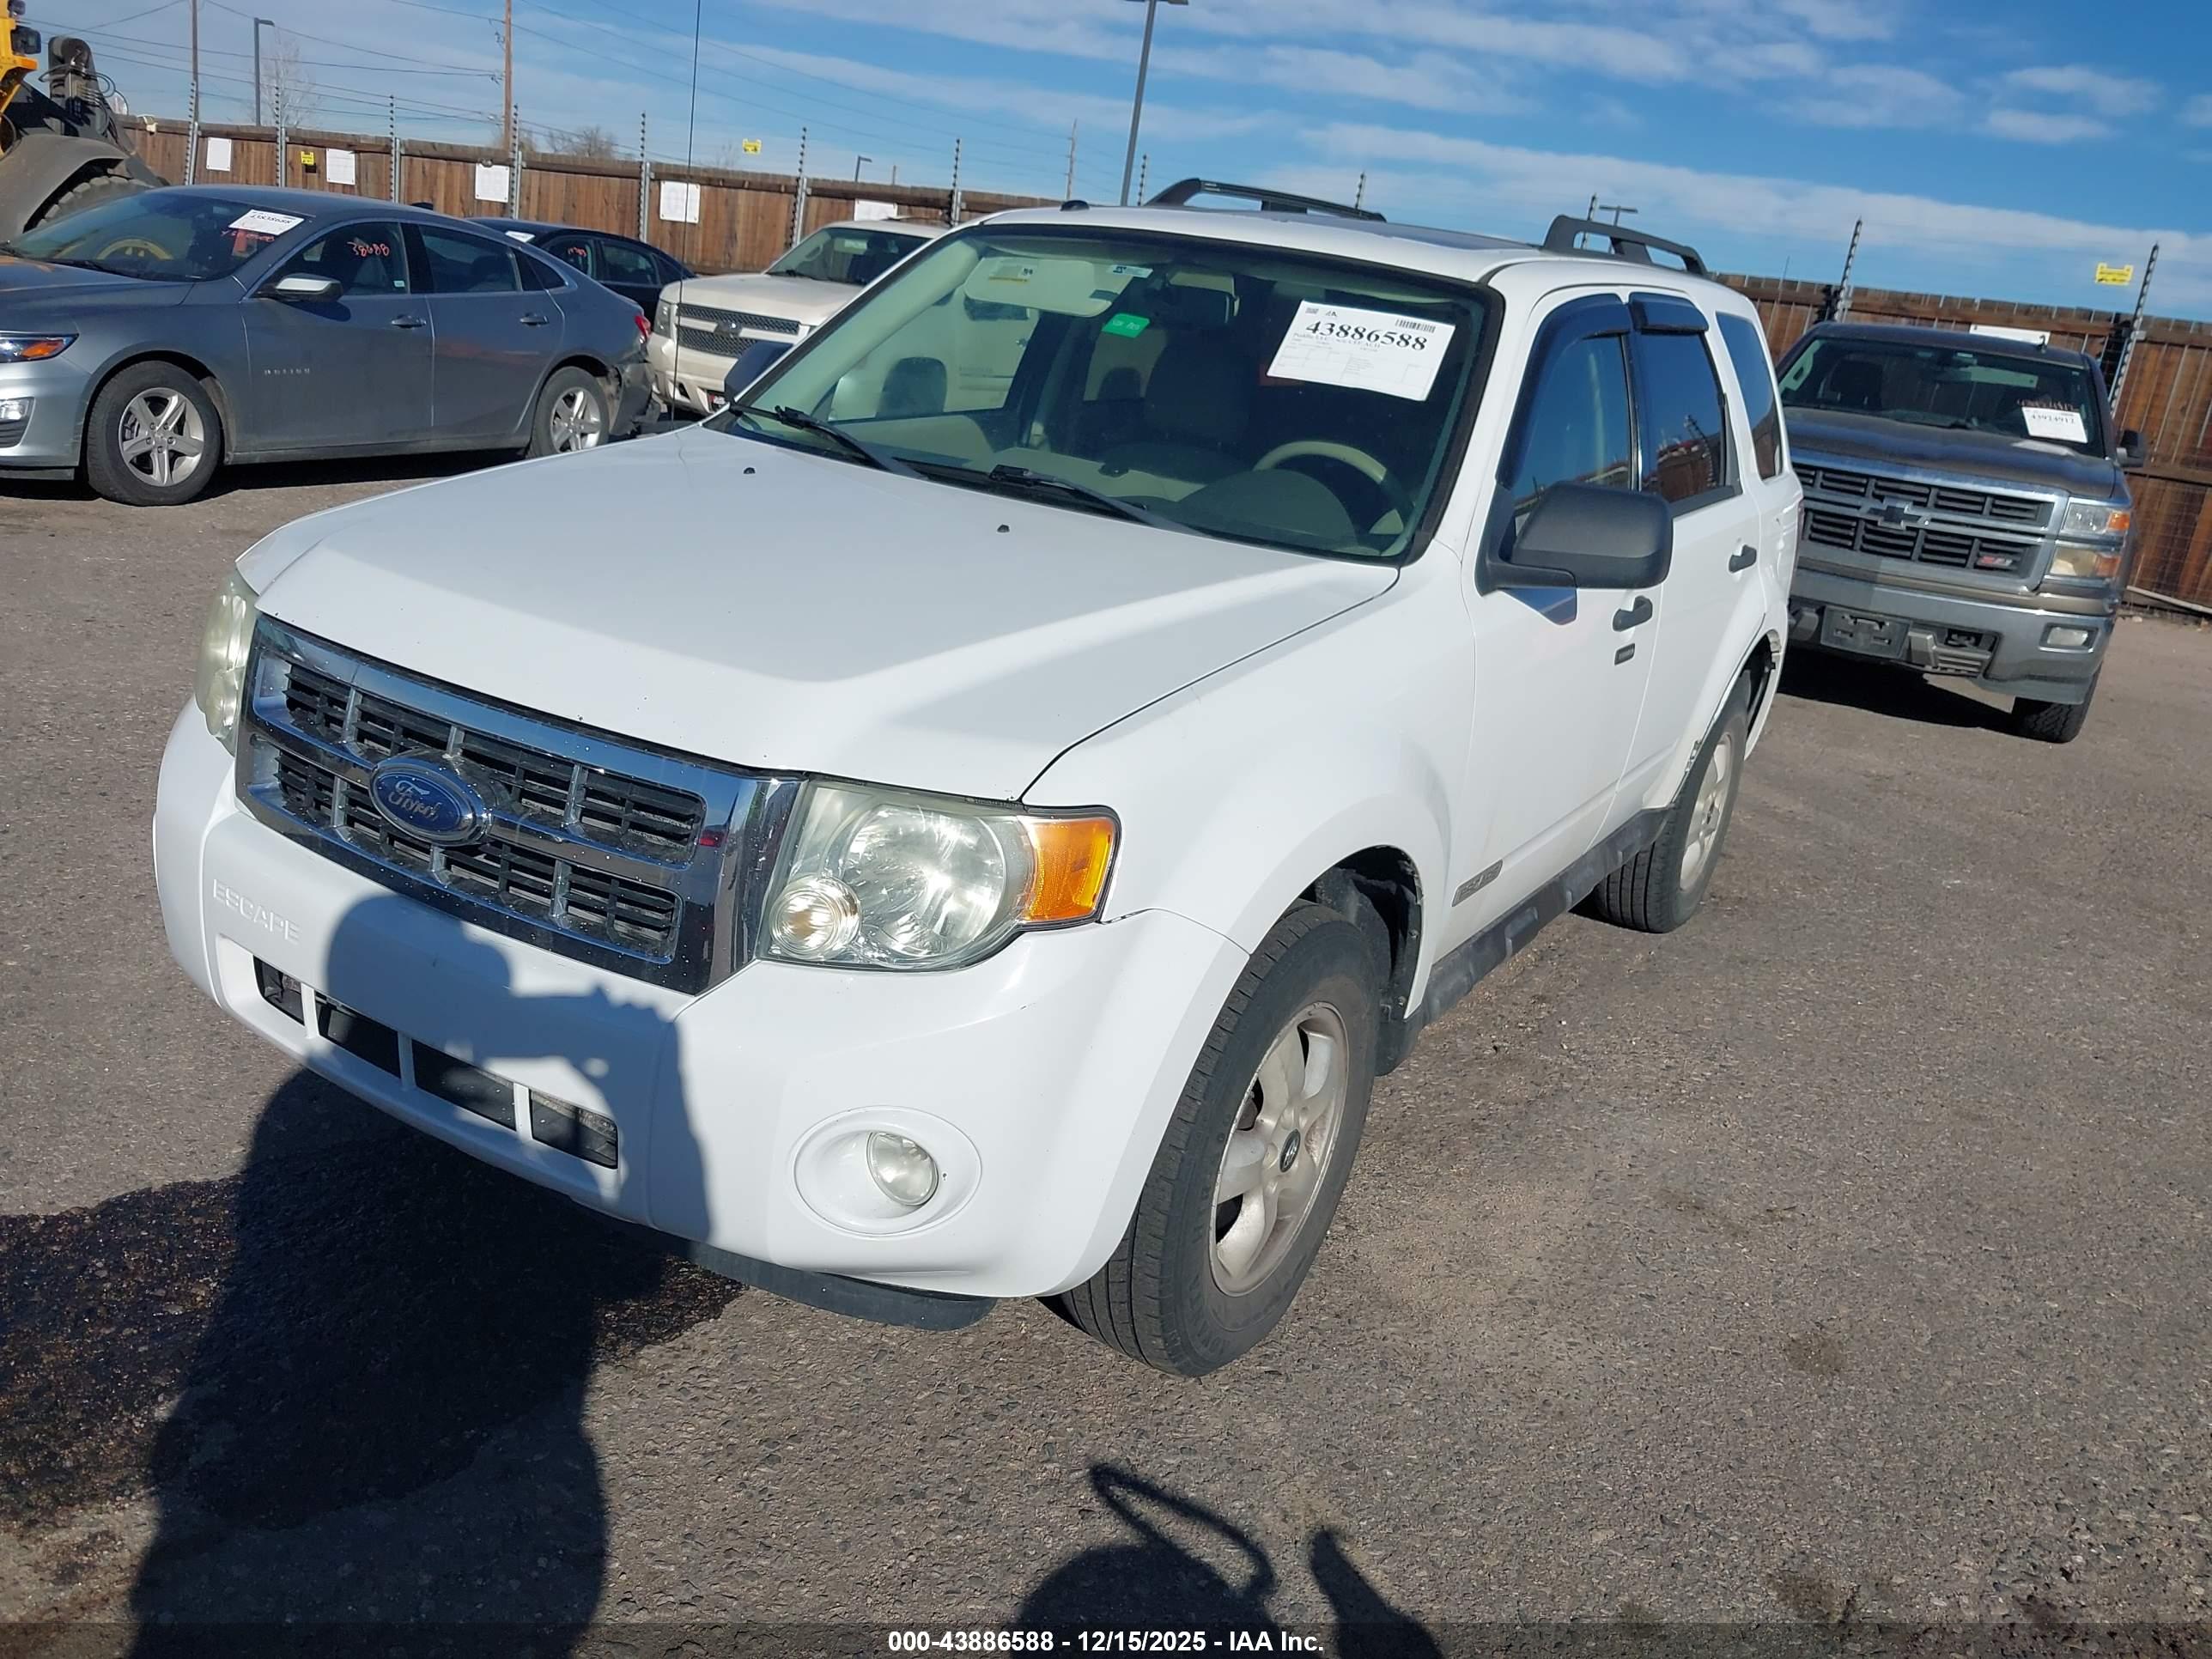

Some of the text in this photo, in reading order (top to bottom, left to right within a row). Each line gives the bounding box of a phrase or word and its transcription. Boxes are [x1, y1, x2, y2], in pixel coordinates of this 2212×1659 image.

[1305, 320, 1428, 351] 43886588
[387, 780, 444, 822] Ford
[213, 878, 301, 945] ESCAPE
